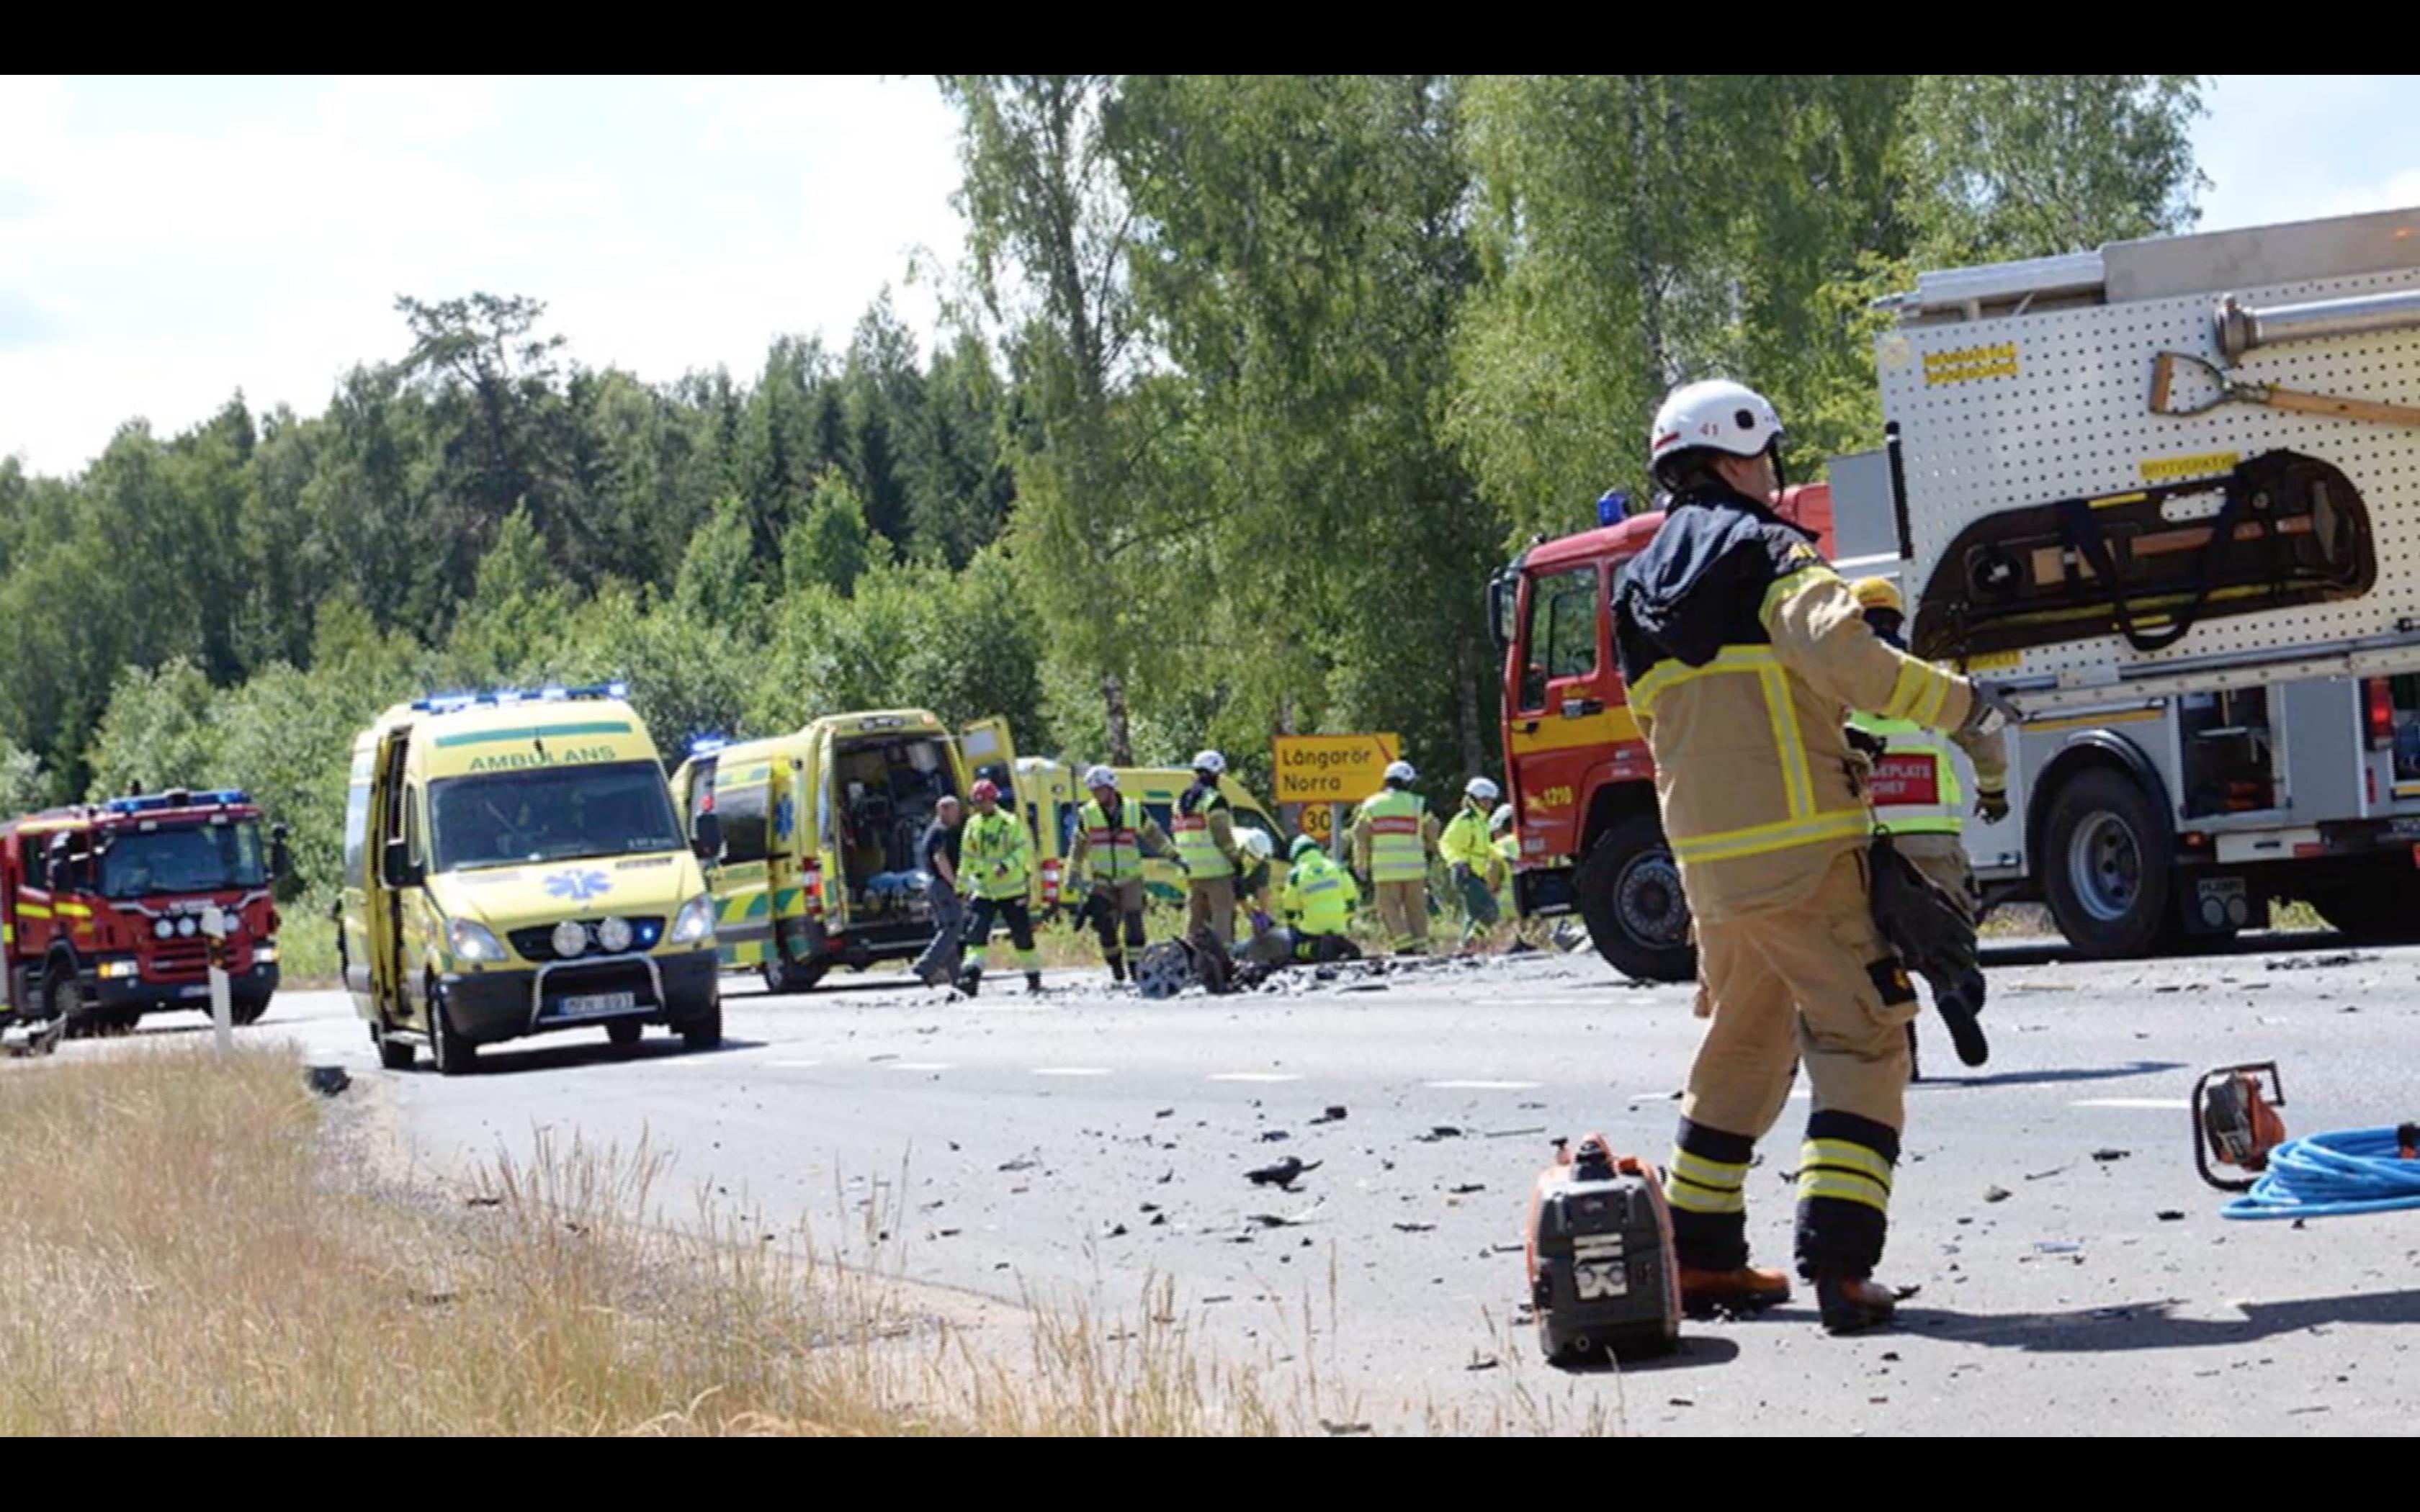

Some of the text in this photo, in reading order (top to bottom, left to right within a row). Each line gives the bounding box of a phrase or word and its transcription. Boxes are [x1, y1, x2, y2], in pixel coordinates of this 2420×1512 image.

[469, 744, 617, 771] AMBULANS
[1281, 747, 1371, 770] Långarör
[1283, 773, 1342, 792] Norra
[1307, 811, 1331, 832] 30
